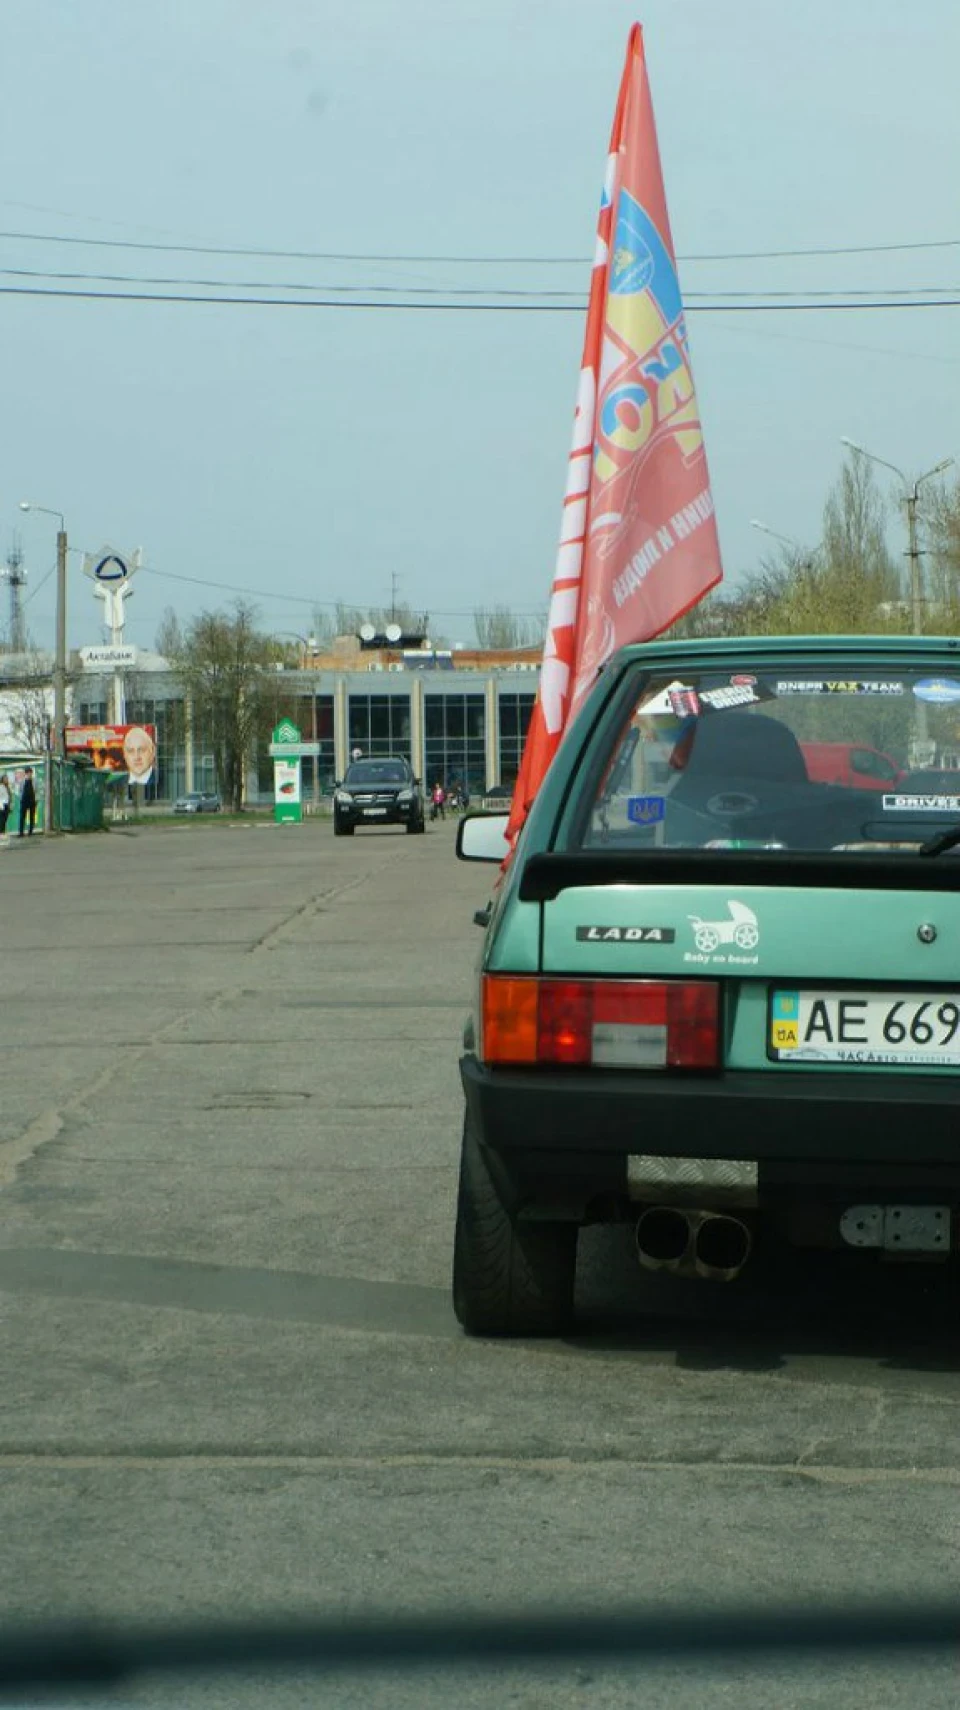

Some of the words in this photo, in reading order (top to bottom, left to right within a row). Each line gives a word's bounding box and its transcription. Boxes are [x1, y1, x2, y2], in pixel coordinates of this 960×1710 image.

[862, 682, 902, 692] TEAM
[587, 927, 663, 941] LADA
[683, 952, 711, 964] Baby
[727, 953, 759, 965] board
[804, 999, 869, 1043] AE
